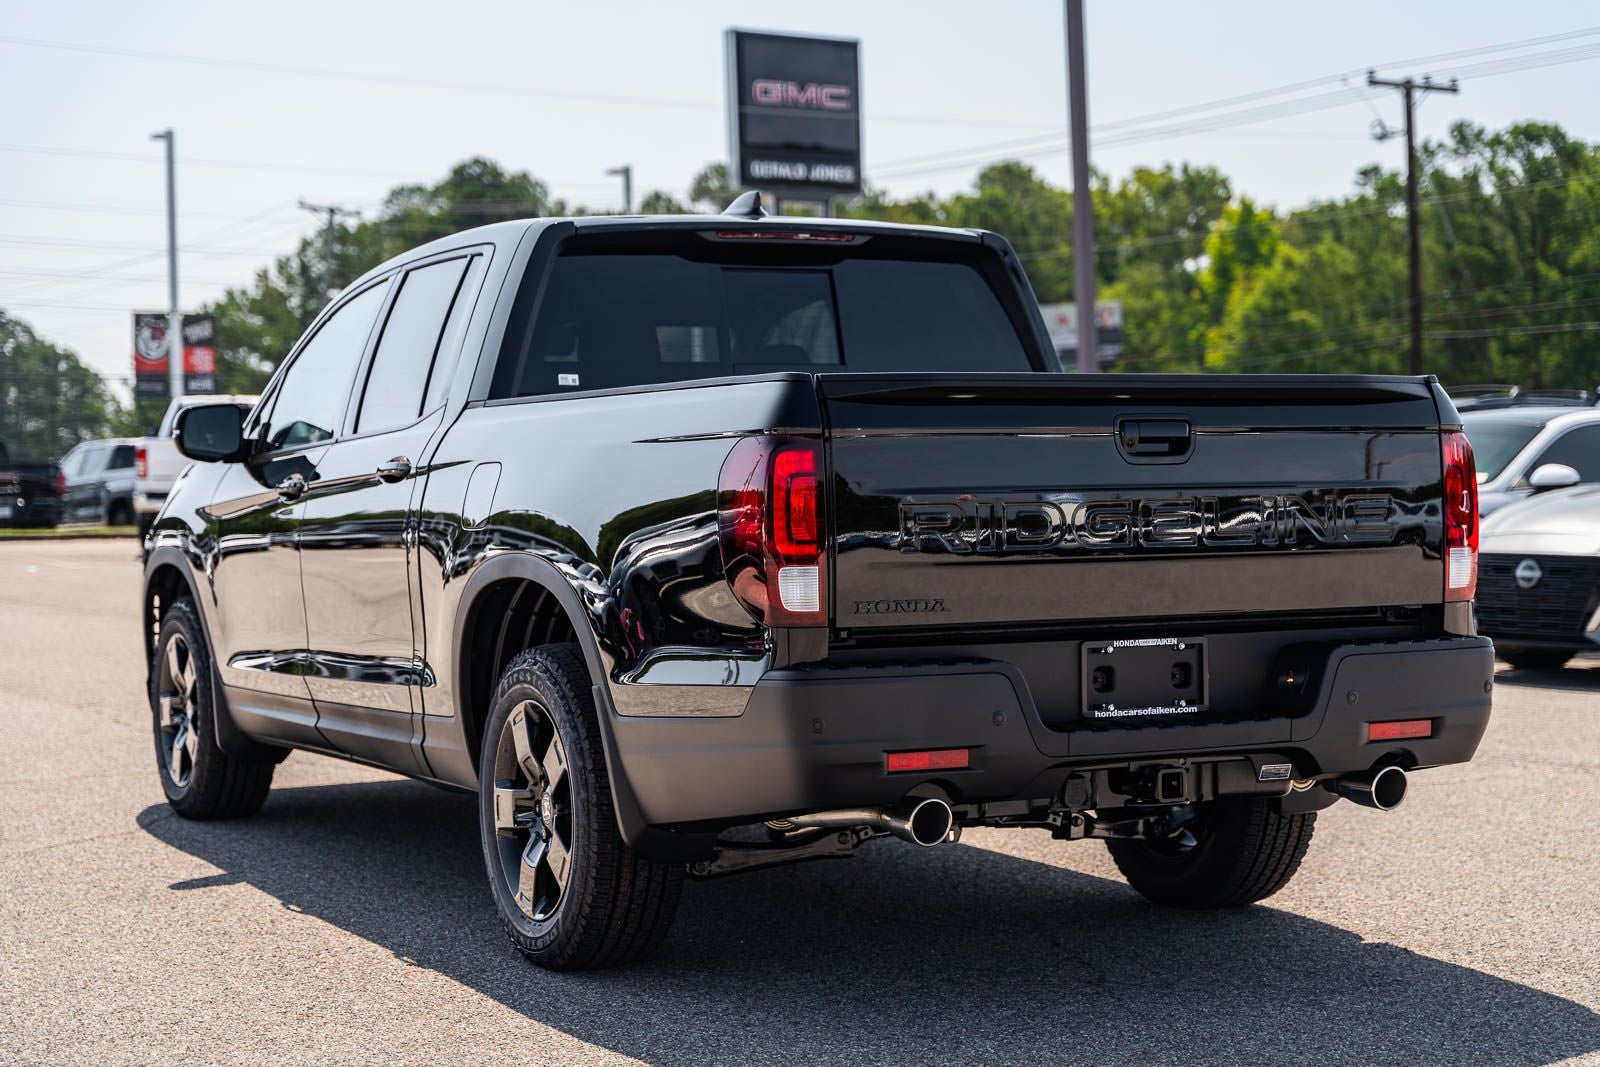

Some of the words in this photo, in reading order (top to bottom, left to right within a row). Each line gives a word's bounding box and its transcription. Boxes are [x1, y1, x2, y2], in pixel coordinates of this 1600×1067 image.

[753, 81, 849, 110] GMC
[900, 494, 1394, 553] RIDGELINE
[854, 599, 946, 614] HONDA
[1156, 638, 1178, 646] AIKEN
[1094, 705, 1198, 718] hondacarsofaiken.com
